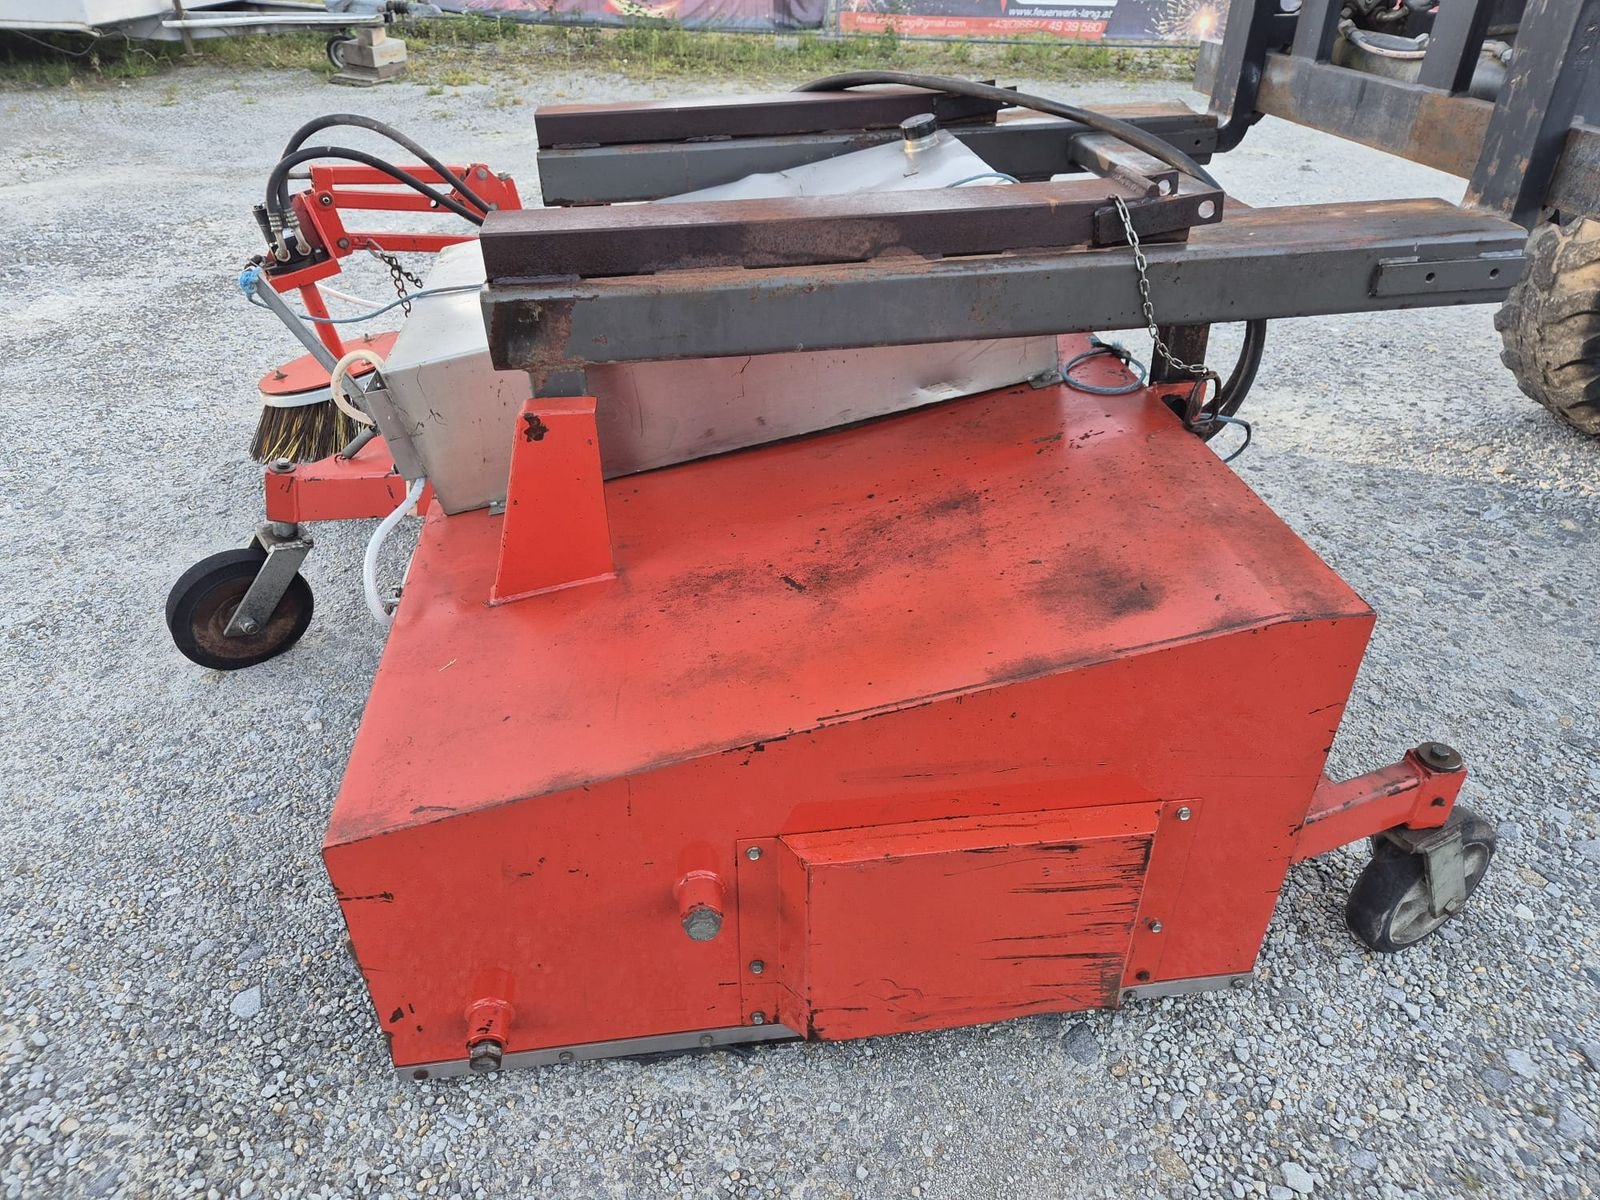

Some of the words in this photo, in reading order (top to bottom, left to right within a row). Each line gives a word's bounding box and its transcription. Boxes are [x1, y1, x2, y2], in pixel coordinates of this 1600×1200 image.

[1008, 7, 1113, 20] www.feuerwerk-lang.at
[1048, 20, 1063, 31] 49
[1064, 21, 1079, 32] 39
